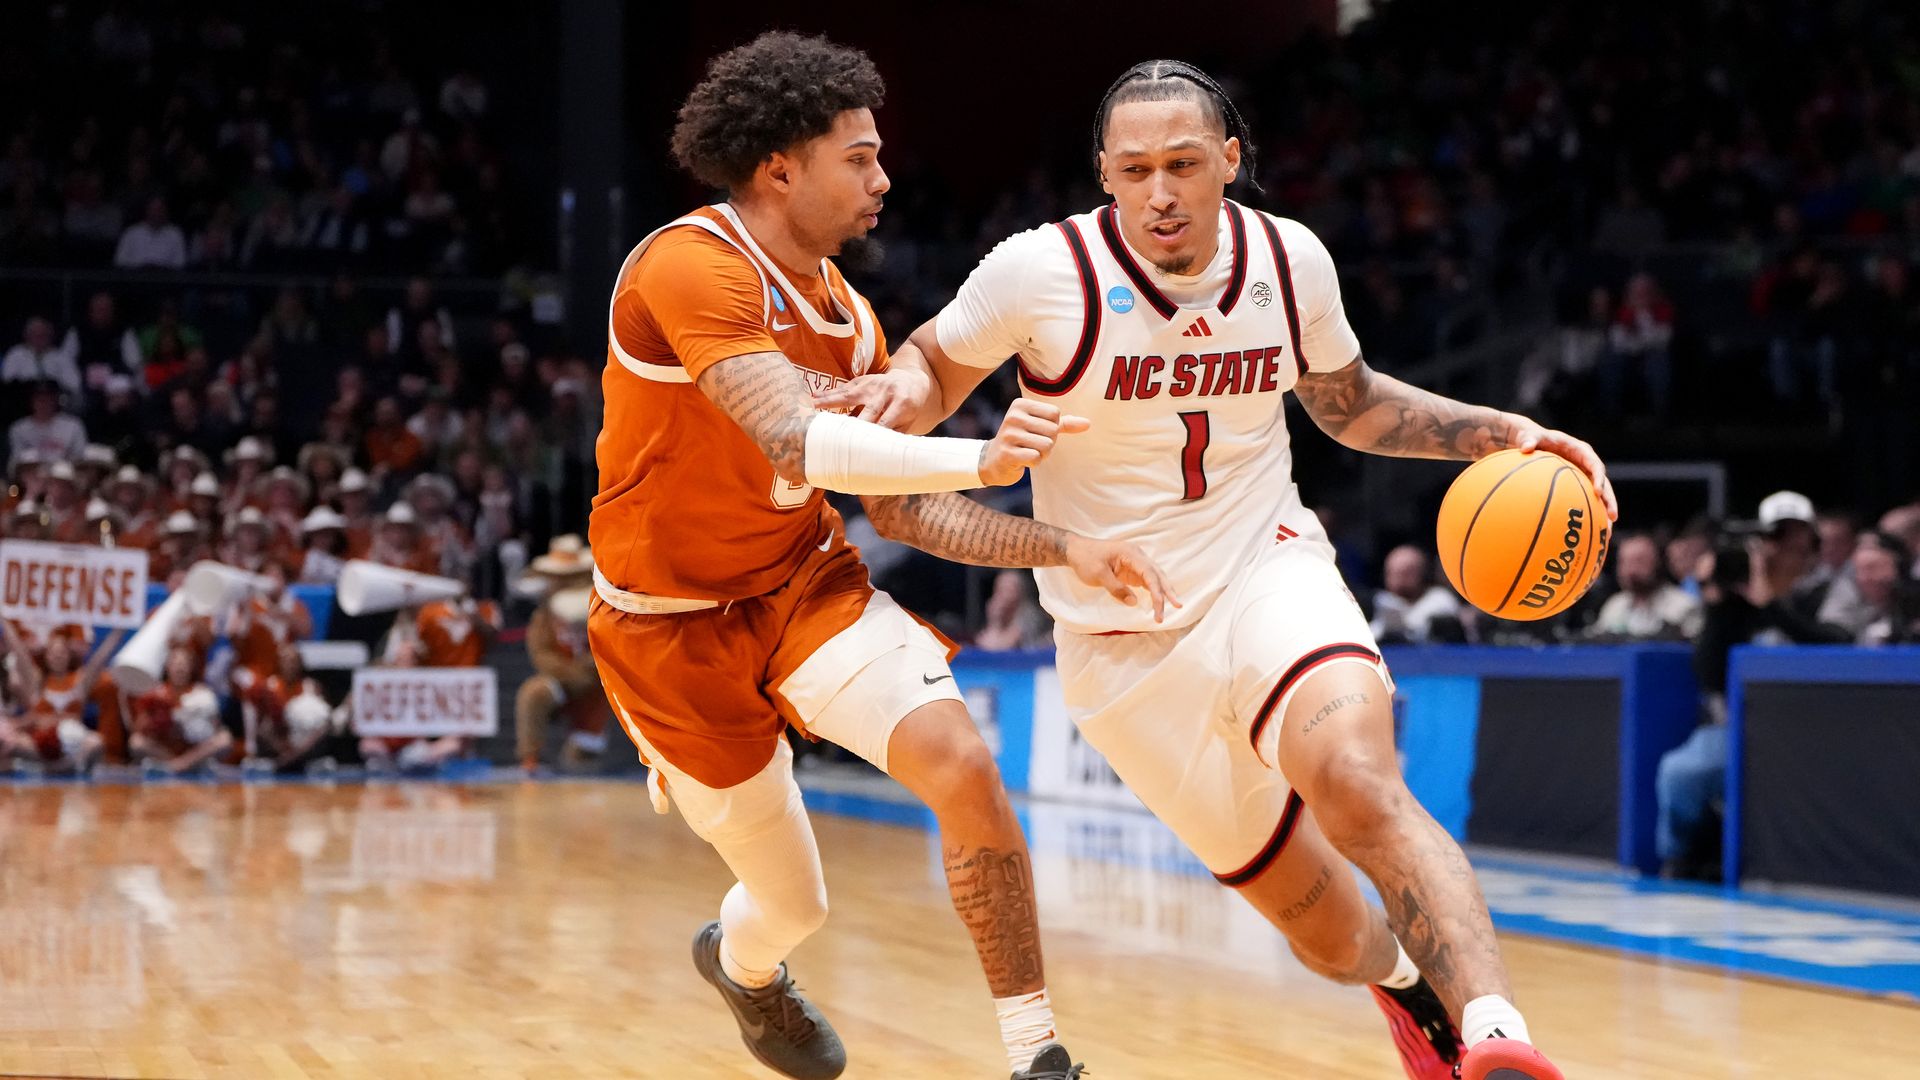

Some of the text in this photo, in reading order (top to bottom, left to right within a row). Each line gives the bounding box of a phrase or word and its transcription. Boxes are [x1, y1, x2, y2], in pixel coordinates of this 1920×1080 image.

[1111, 298, 1133, 306] NCAA
[1104, 346, 1282, 400] NC STATE
[1177, 410, 1210, 501] 1
[1518, 507, 1583, 609] Wilson
[4, 560, 135, 616] DEFENSE
[361, 680, 484, 722] DEFENSE
[1302, 692, 1370, 736] SACRIFICE
[1278, 864, 1333, 923] HUMBLE
